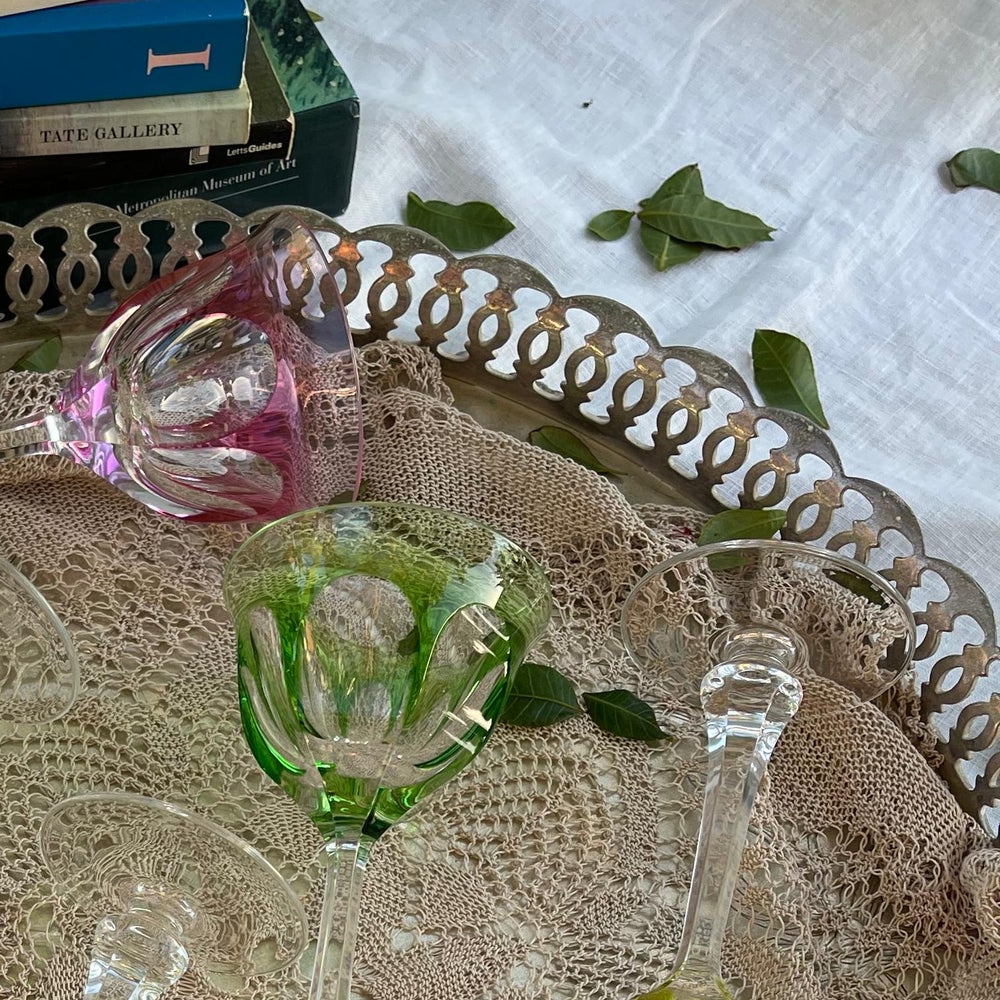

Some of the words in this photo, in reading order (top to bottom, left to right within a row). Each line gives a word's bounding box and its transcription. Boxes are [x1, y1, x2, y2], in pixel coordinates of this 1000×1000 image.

[40, 129, 89, 144] TATE
[94, 122, 183, 141] GALLERY
[201, 170, 256, 192] Museum
[259, 162, 274, 176] of
[275, 158, 297, 172] Art
